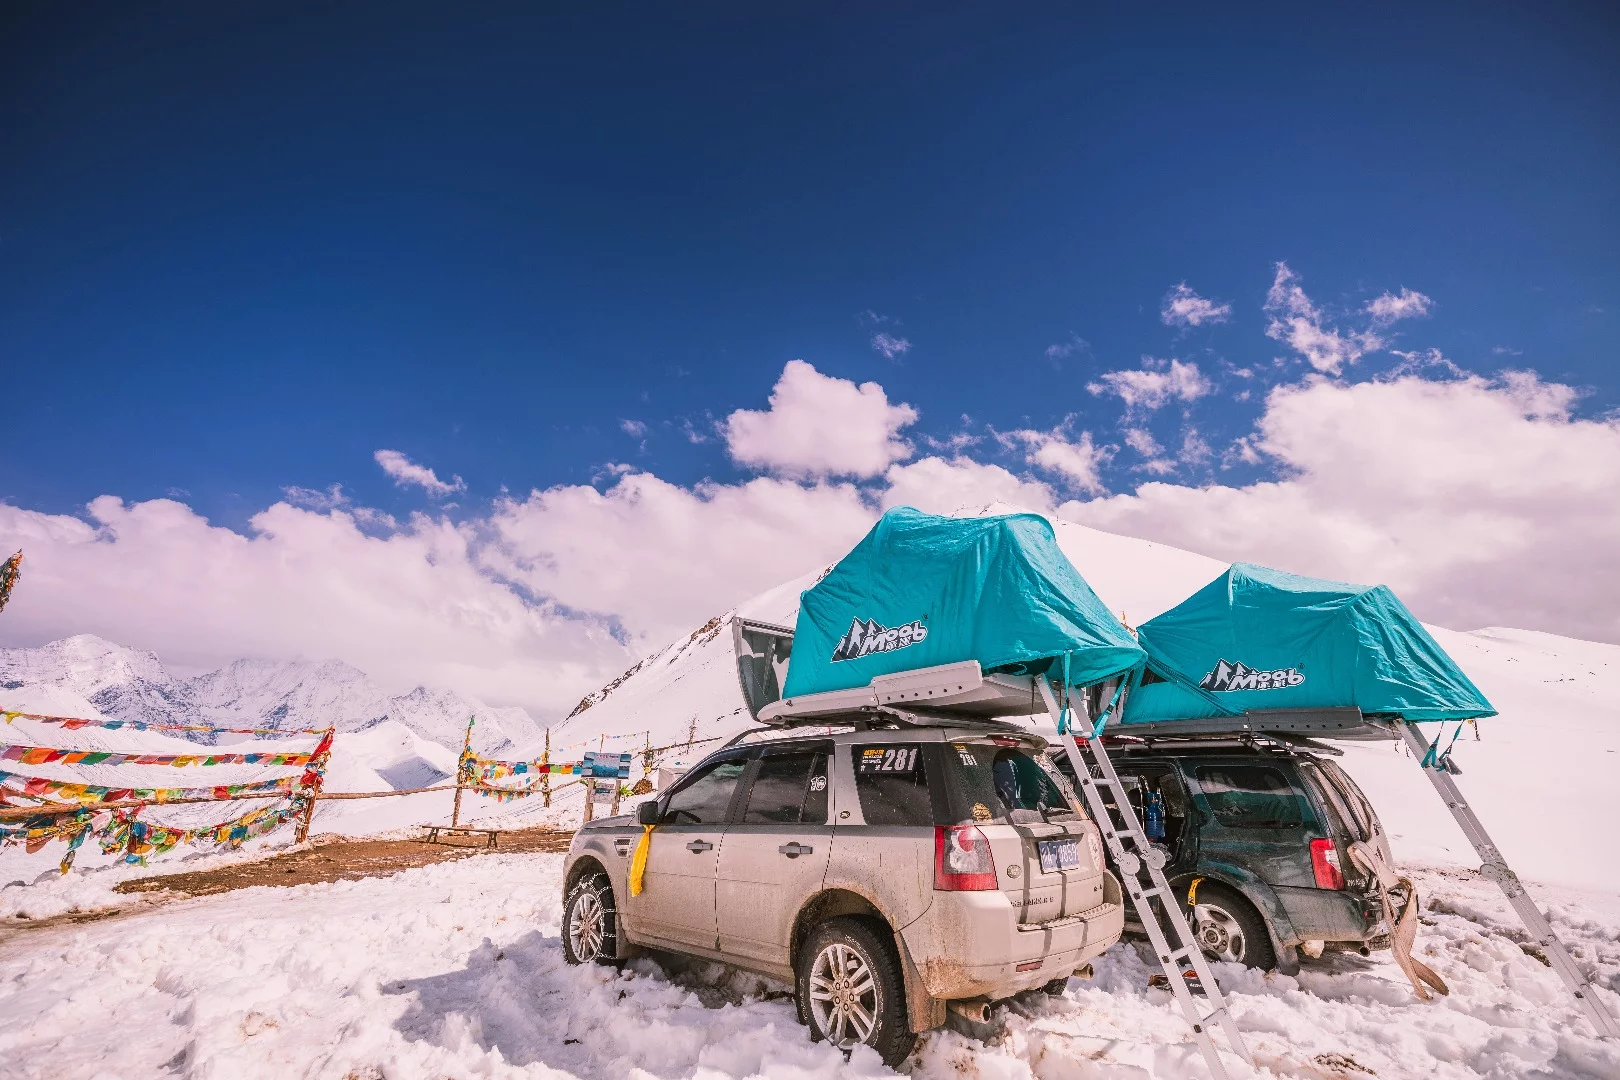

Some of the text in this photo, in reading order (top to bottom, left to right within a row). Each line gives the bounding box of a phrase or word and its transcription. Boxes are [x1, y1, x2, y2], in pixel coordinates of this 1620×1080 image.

[858, 620, 926, 656] Moob
[1226, 668, 1304, 691] Moob
[882, 748, 917, 771] 281
[960, 753, 977, 766] 281
